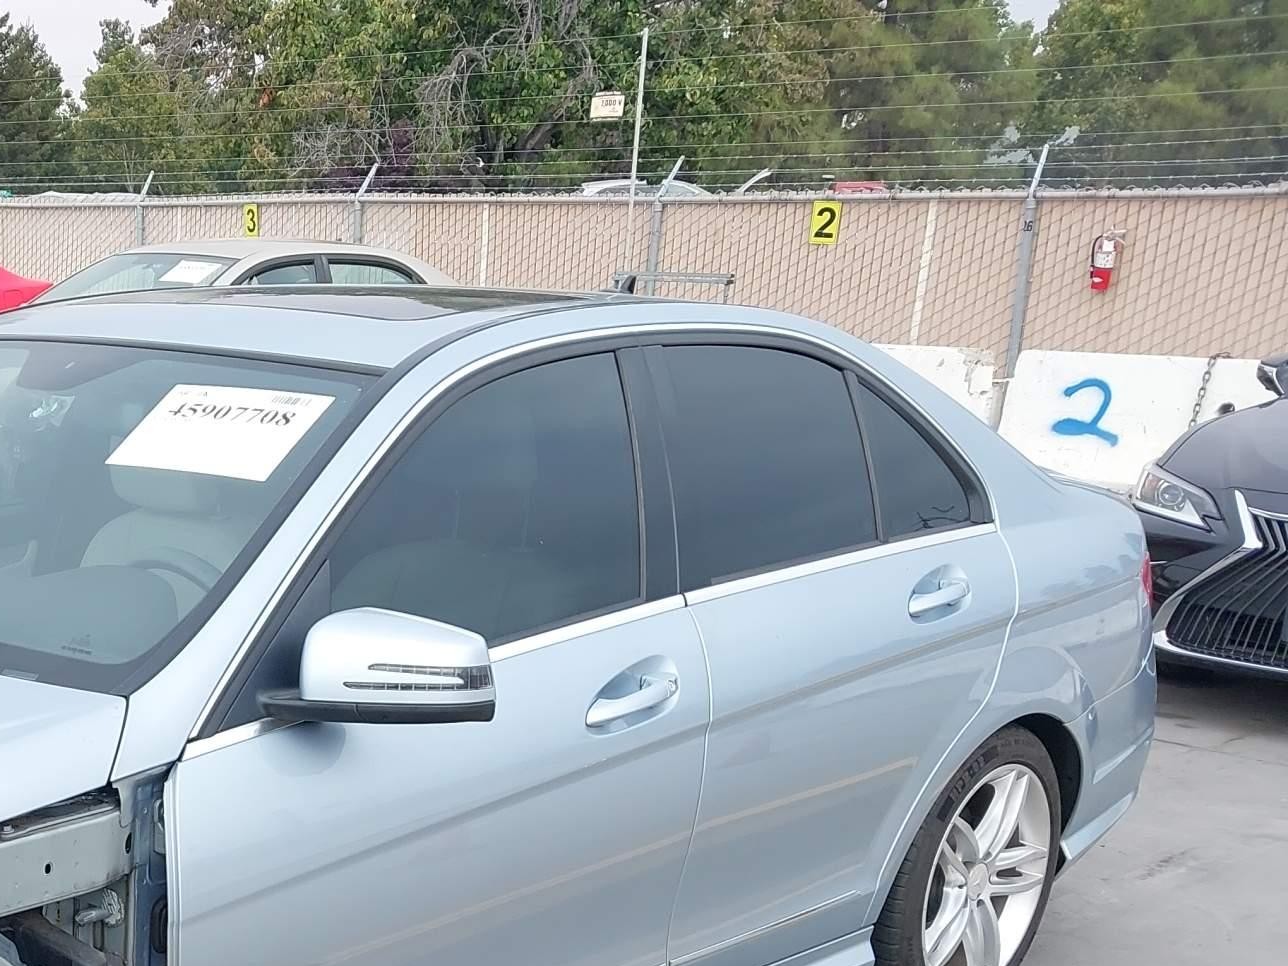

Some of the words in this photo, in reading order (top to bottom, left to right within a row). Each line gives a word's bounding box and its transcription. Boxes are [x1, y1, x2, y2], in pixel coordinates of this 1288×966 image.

[246, 208, 257, 233] 3
[813, 206, 836, 239] 2
[168, 402, 297, 427] 45907708
[1050, 378, 1119, 448] 2
